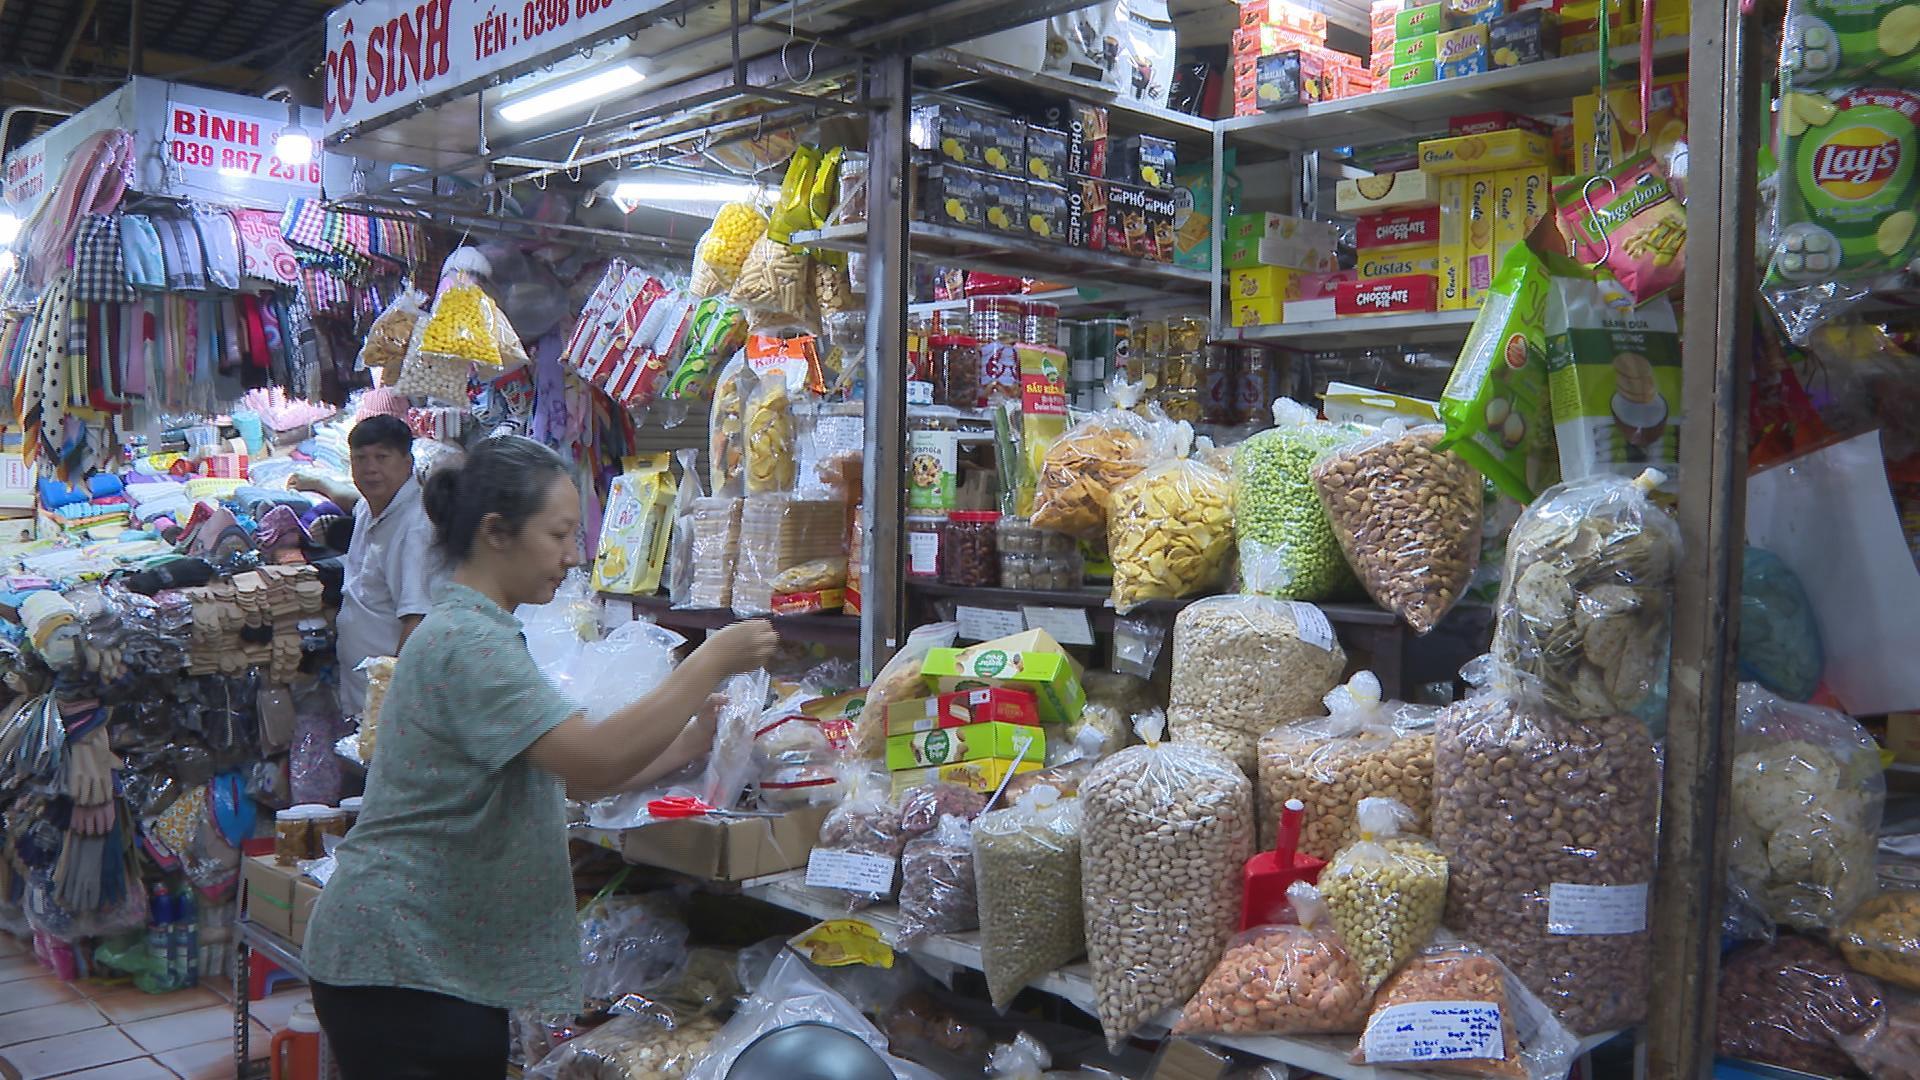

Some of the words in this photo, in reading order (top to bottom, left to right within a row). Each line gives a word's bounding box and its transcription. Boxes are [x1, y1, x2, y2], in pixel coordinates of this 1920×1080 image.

[473, 5, 507, 61] YẾN
[523, 0, 570, 41] 0398
[325, 18, 357, 123] CÔ
[366, 0, 450, 104] SINH
[173, 108, 260, 147] BÌNH
[173, 139, 214, 167] 039
[222, 148, 262, 174] 867
[269, 155, 321, 184] 2316
[1819, 143, 1897, 184] Lay's
[1376, 221, 1425, 239] CHOCOLATE
[1394, 230, 1409, 240] PIE
[1363, 260, 1413, 277] Custas
[1356, 290, 1408, 306] CHOCOLATE
[1375, 298, 1391, 308] PIE
